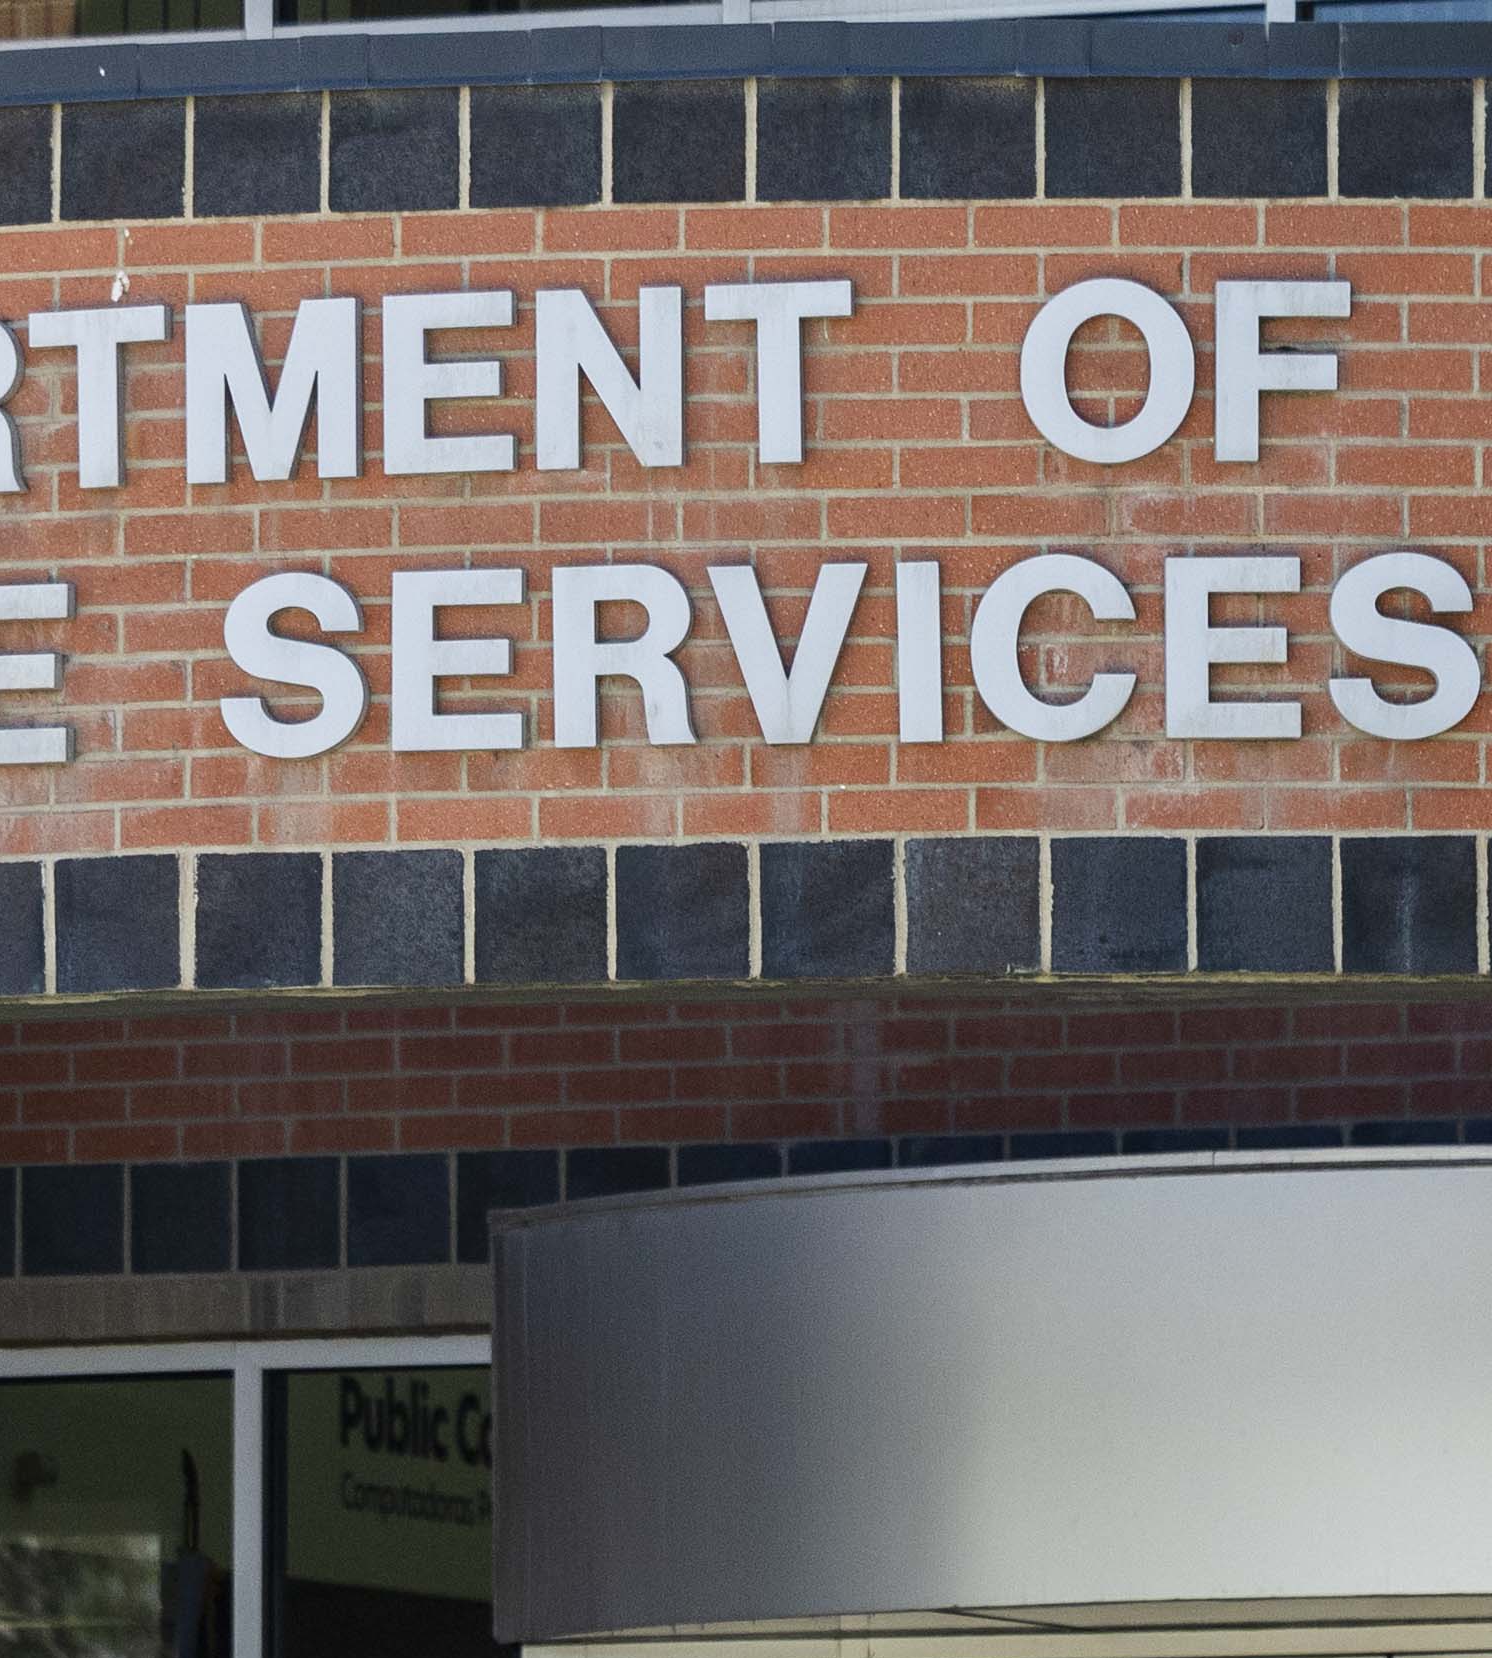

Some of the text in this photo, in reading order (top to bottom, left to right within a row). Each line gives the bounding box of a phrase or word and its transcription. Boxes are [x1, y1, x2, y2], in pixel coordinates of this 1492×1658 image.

[1020, 277, 1353, 466] OF
[220, 549, 1482, 760] SERVICES
[340, 1375, 449, 1463] Public
